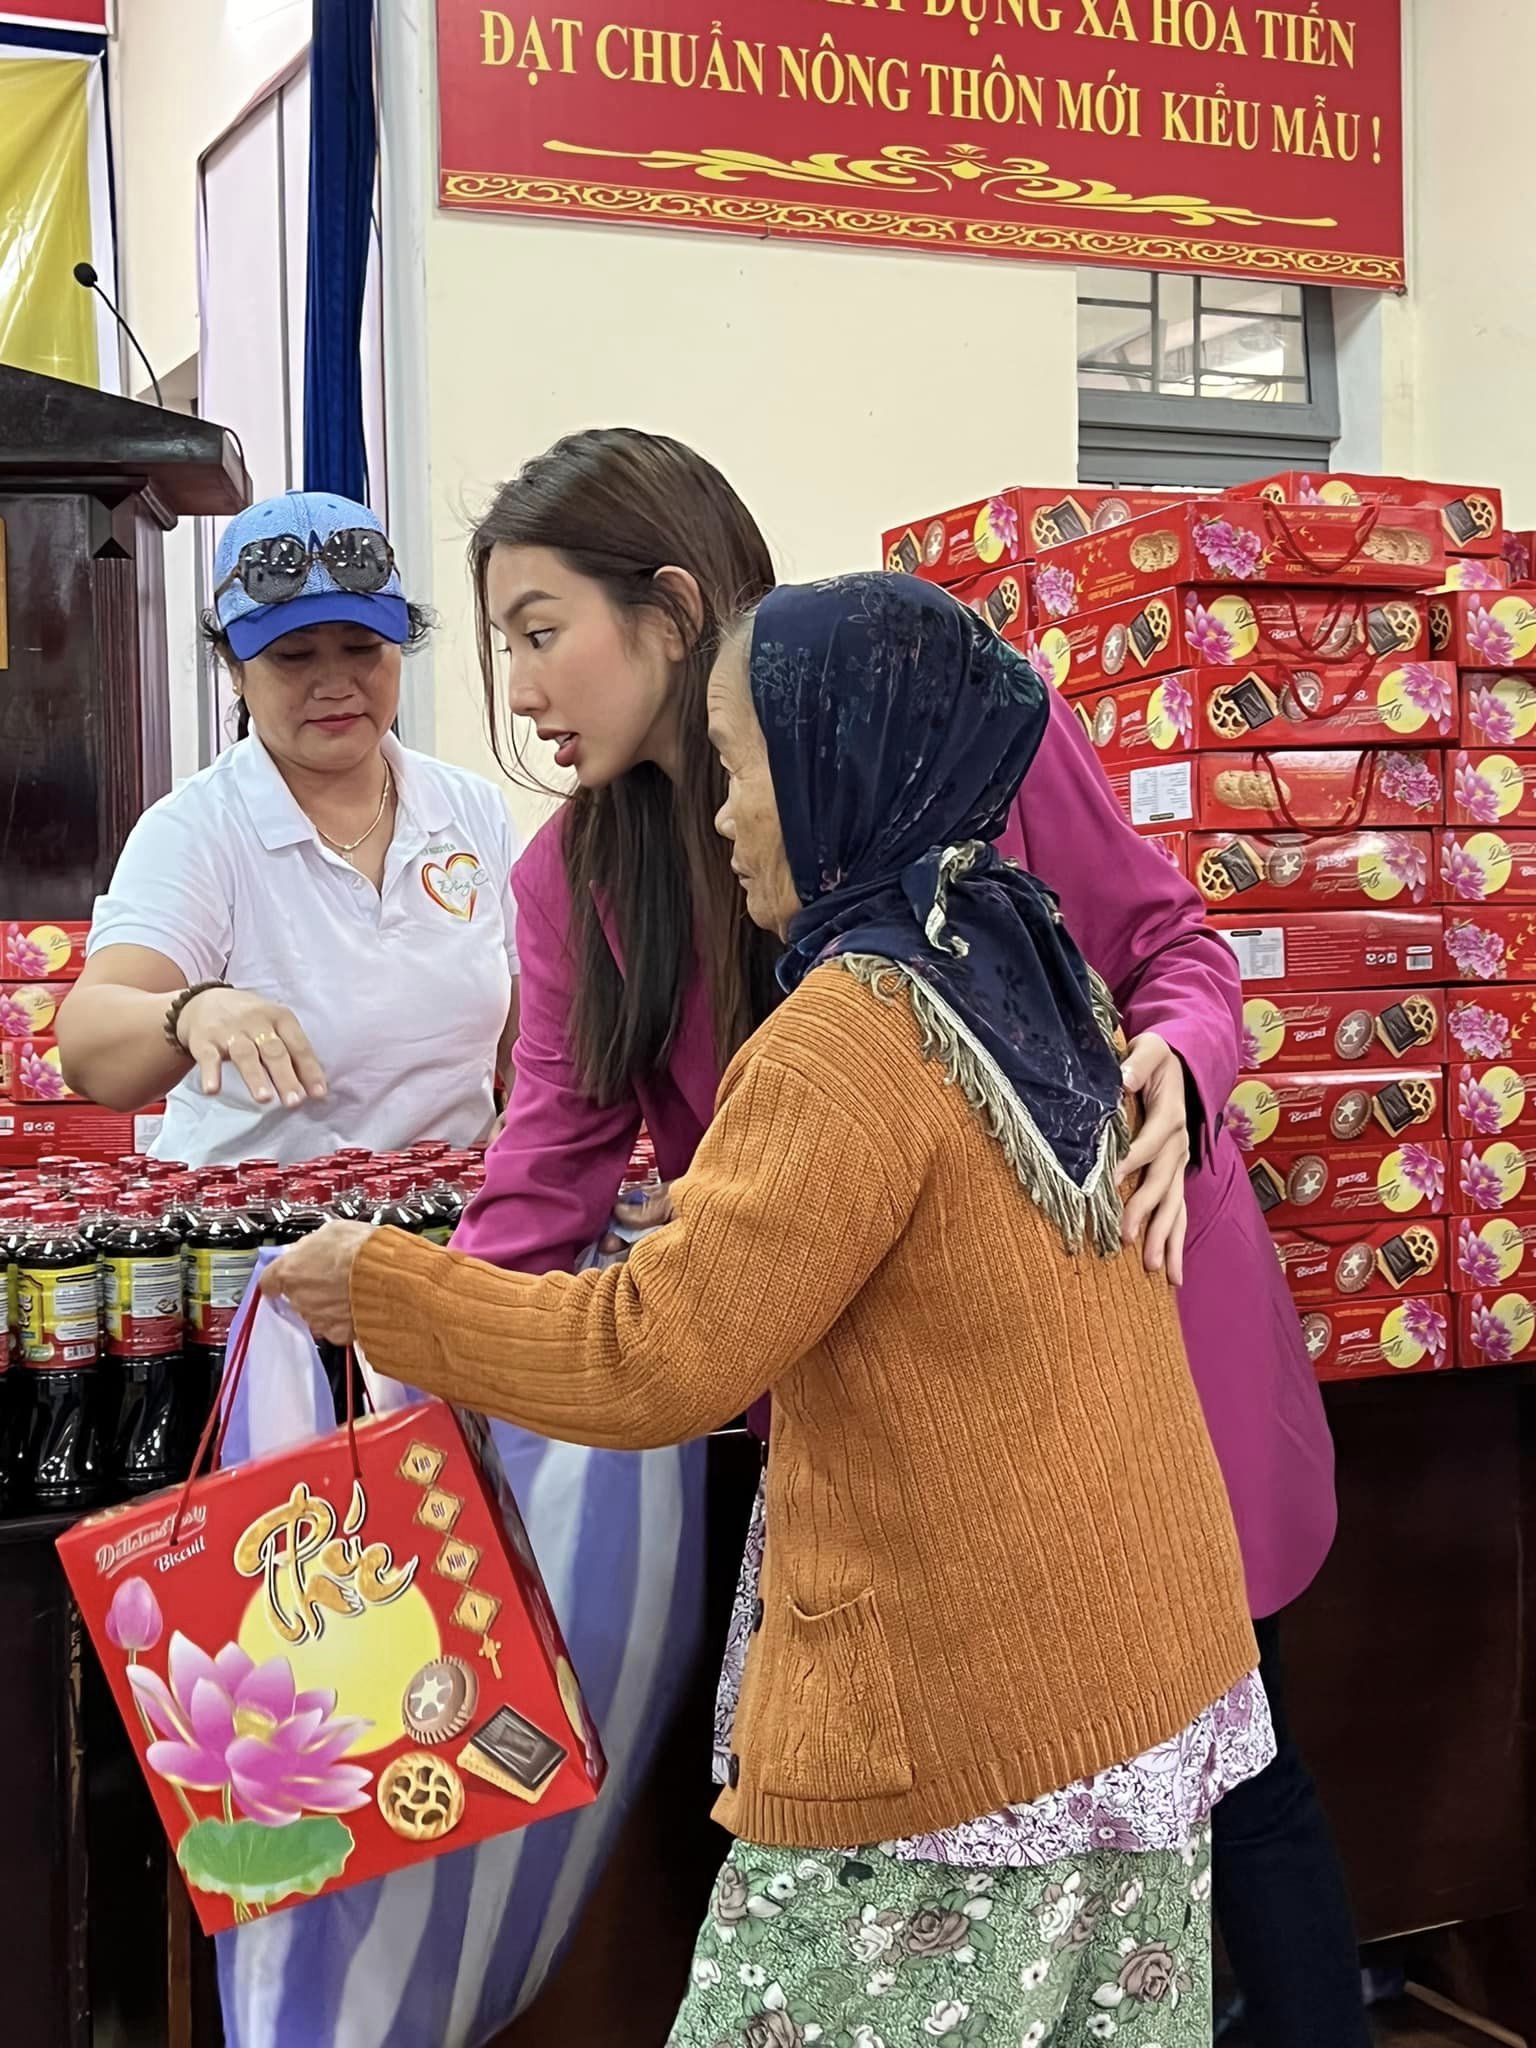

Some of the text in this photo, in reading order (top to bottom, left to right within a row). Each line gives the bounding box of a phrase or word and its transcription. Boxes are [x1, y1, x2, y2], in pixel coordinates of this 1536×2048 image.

[1256, 2, 1357, 70] TIẾN
[480, 10, 583, 86] ĐẠT
[596, 20, 766, 95] CHUẨN
[778, 33, 912, 111] NÔNG
[921, 53, 1044, 126] THÔN
[1056, 69, 1141, 137] MỚI
[1161, 82, 1261, 151] KIỂU
[1272, 95, 1360, 162] MẪU
[154, 1535, 206, 1573] Biscuit
